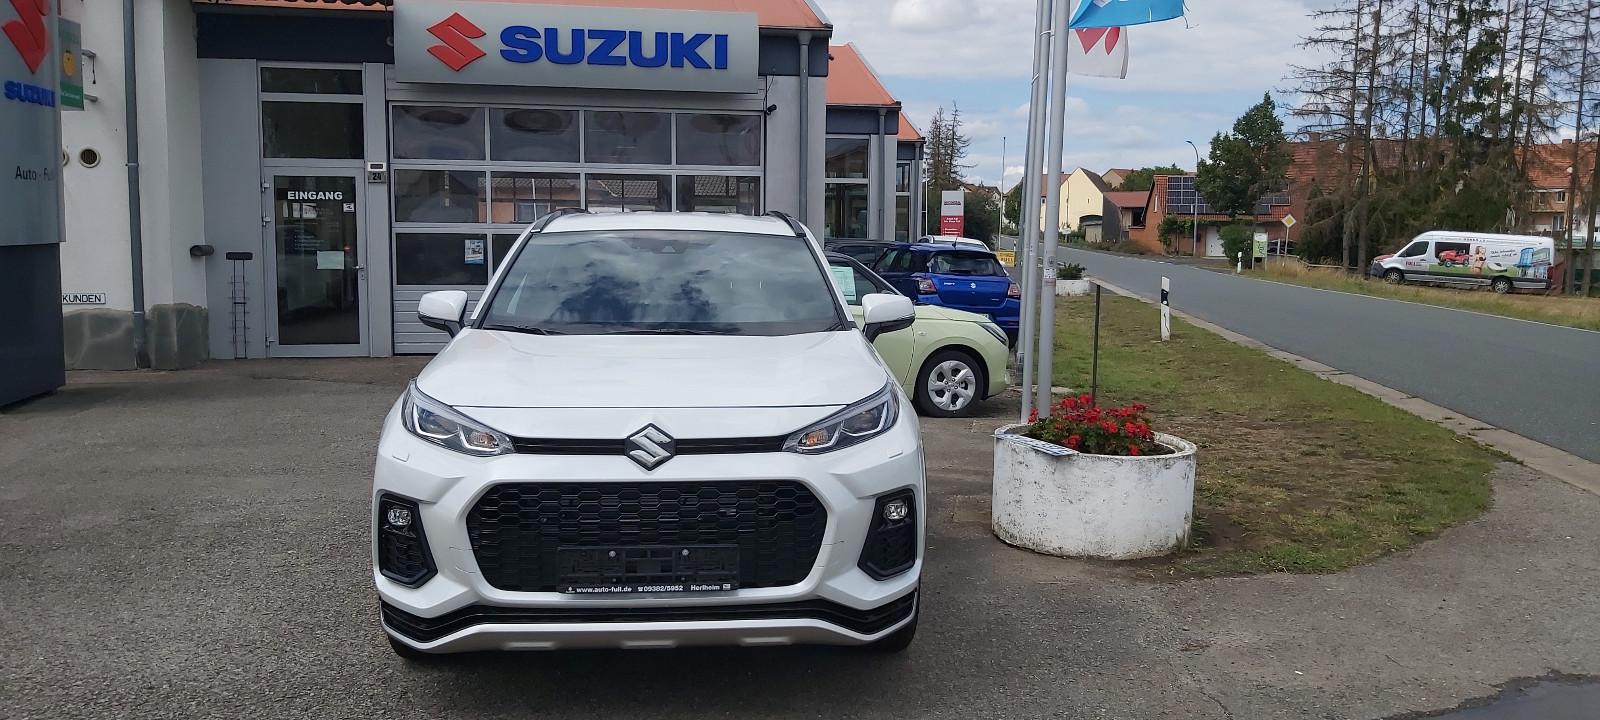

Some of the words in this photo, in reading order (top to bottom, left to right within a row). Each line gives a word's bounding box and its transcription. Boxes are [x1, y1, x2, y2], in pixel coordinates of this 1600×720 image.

[500, 25, 728, 70] SUZUKI
[4, 80, 55, 108] SUZUKI
[15, 165, 37, 180] Auto
[372, 172, 382, 181] 24
[287, 191, 343, 200] EINGANG
[62, 294, 102, 303] KUNDEN
[576, 585, 632, 593] www.auto-full.de
